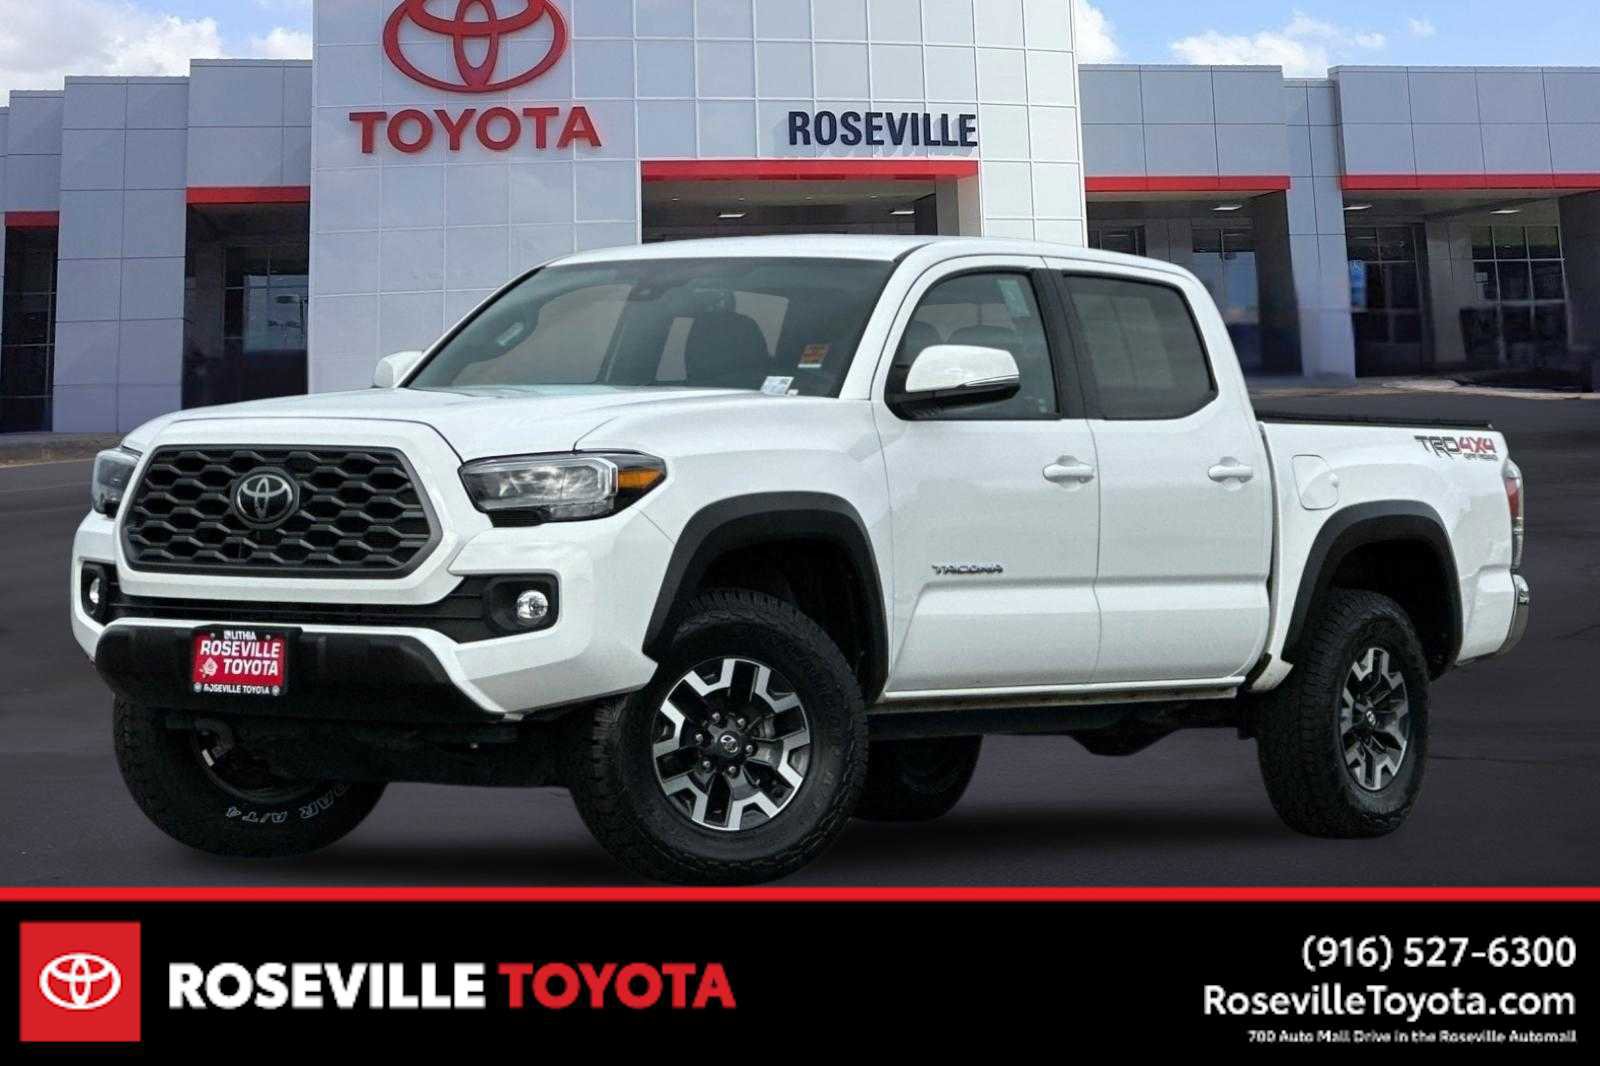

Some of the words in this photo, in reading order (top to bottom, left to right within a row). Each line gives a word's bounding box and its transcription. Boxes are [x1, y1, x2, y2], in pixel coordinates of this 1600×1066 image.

[349, 106, 602, 154] TOYOTA
[788, 110, 979, 147] ROSEVILLE
[200, 640, 281, 658] ROSEVILLE
[223, 658, 279, 676] TOYOTA
